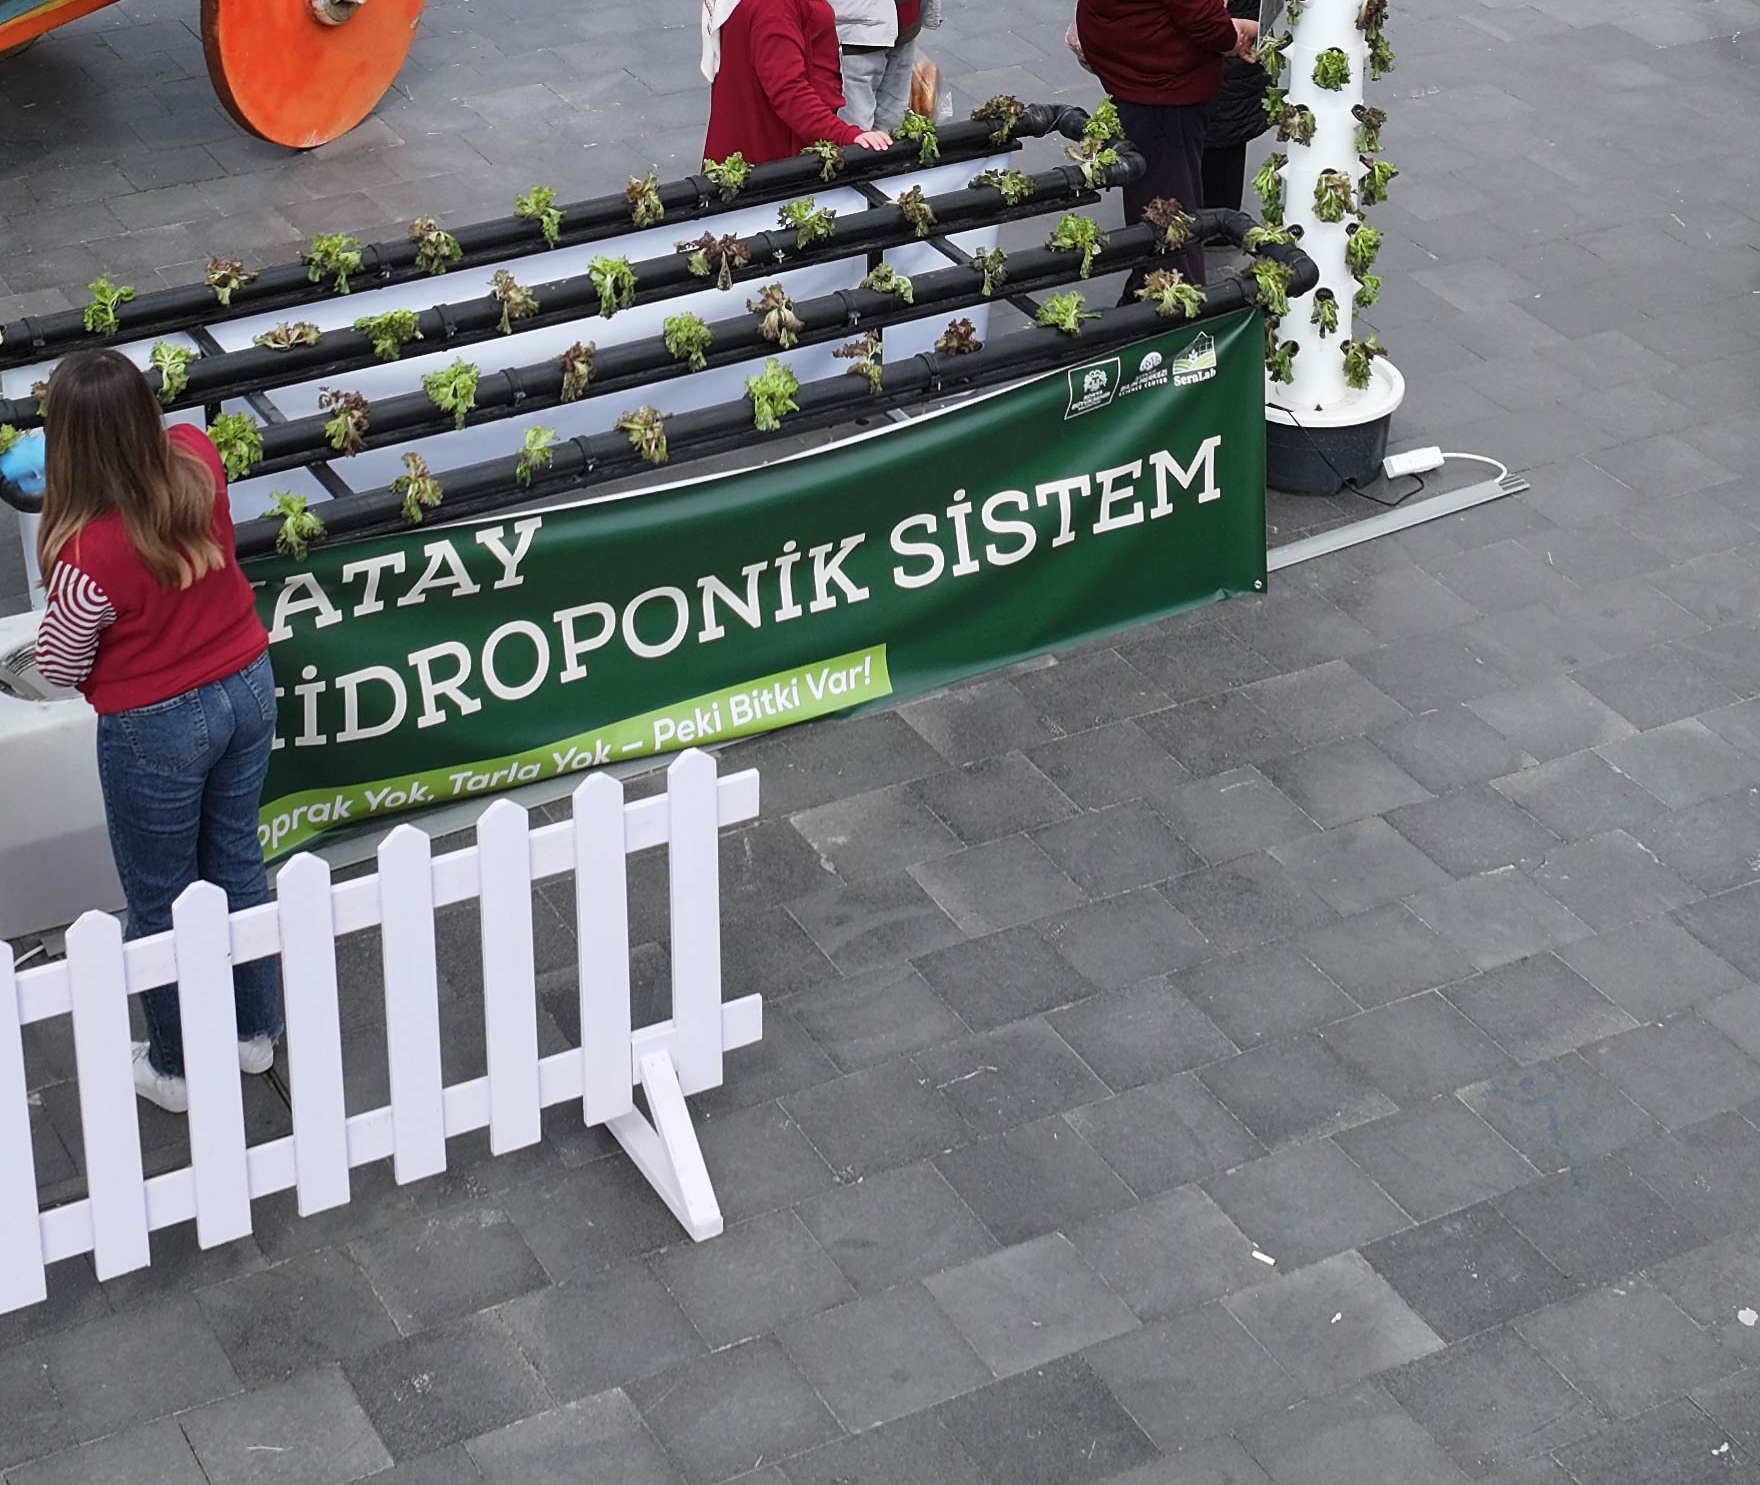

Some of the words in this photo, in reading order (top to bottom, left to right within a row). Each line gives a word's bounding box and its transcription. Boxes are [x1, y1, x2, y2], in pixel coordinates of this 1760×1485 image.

[1144, 377, 1168, 389] CENTER
[1173, 367, 1217, 387] SeraLab
[890, 434, 1222, 589] SİSTEM
[255, 516, 542, 644] ATAY
[256, 794, 352, 848] oprak
[448, 761, 541, 797] Tarla
[551, 738, 612, 774] Yok
[652, 701, 723, 751] Peki
[728, 677, 802, 728] Bitki
[805, 655, 872, 701] Var!
